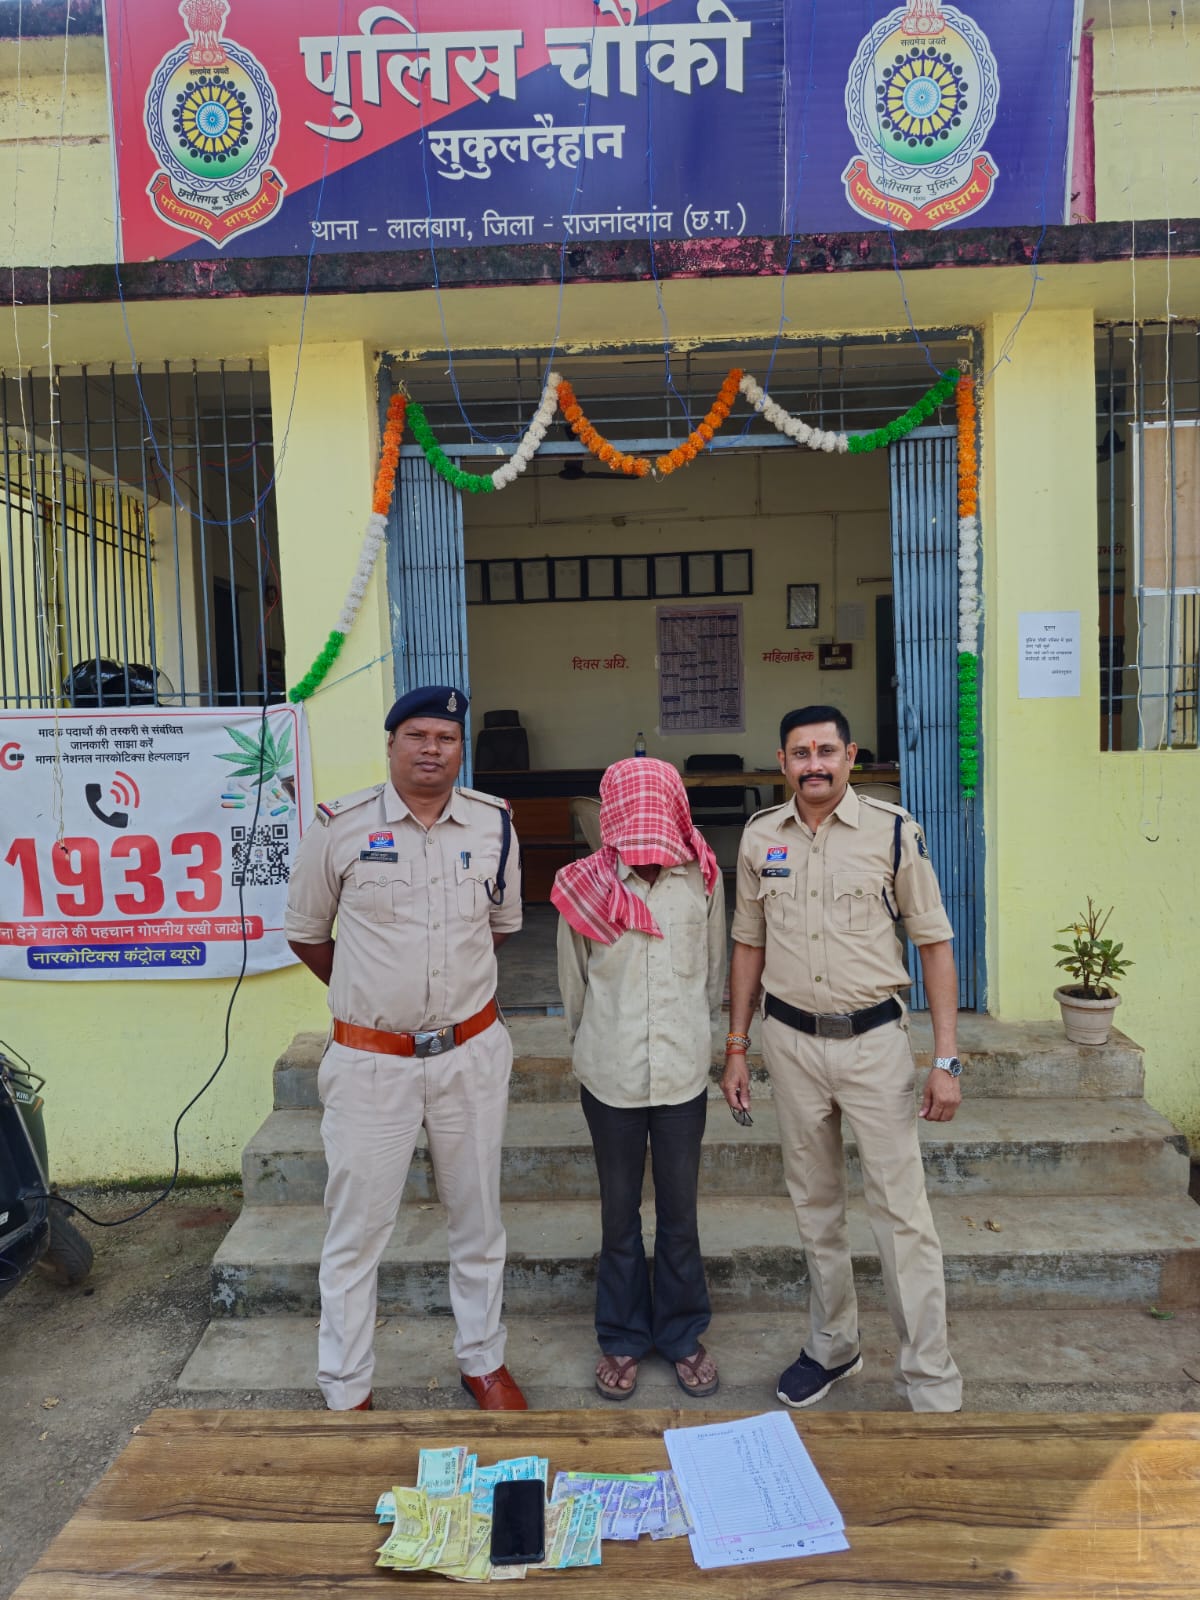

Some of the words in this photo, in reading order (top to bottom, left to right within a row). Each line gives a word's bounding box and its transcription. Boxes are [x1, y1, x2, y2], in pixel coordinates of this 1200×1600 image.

[299, 6, 523, 140] पुलिस
[545, 0, 752, 97] चौकी
[428, 114, 626, 180] सुकुलदैहान
[926, 175, 959, 196] पुलिस
[222, 187, 251, 206] पुलिस
[311, 219, 359, 241] थाना
[387, 217, 474, 241] लालबाग,
[483, 210, 535, 237] जिला
[563, 205, 673, 235] राजनांदगांव
[682, 202, 747, 237] (छ.ग.)
[96, 725, 108, 737] की
[110, 724, 139, 737] तस्करी
[140, 724, 149, 735] से
[151, 723, 184, 735] संबंधित
[70, 737, 110, 750] जानकारी
[62, 752, 92, 764] नेशनल
[4, 831, 223, 917] 1933
[16, 925, 38, 940] देने
[42, 923, 68, 940] वाले
[71, 923, 88, 939] की
[91, 925, 135, 939] पहचान
[138, 920, 184, 937] गोपनीय
[187, 919, 212, 936] रखी
[32, 947, 121, 965] नारकोटिक्स
[124, 946, 167, 966] कंट्रोल
[170, 945, 202, 965] ब्यूरो
